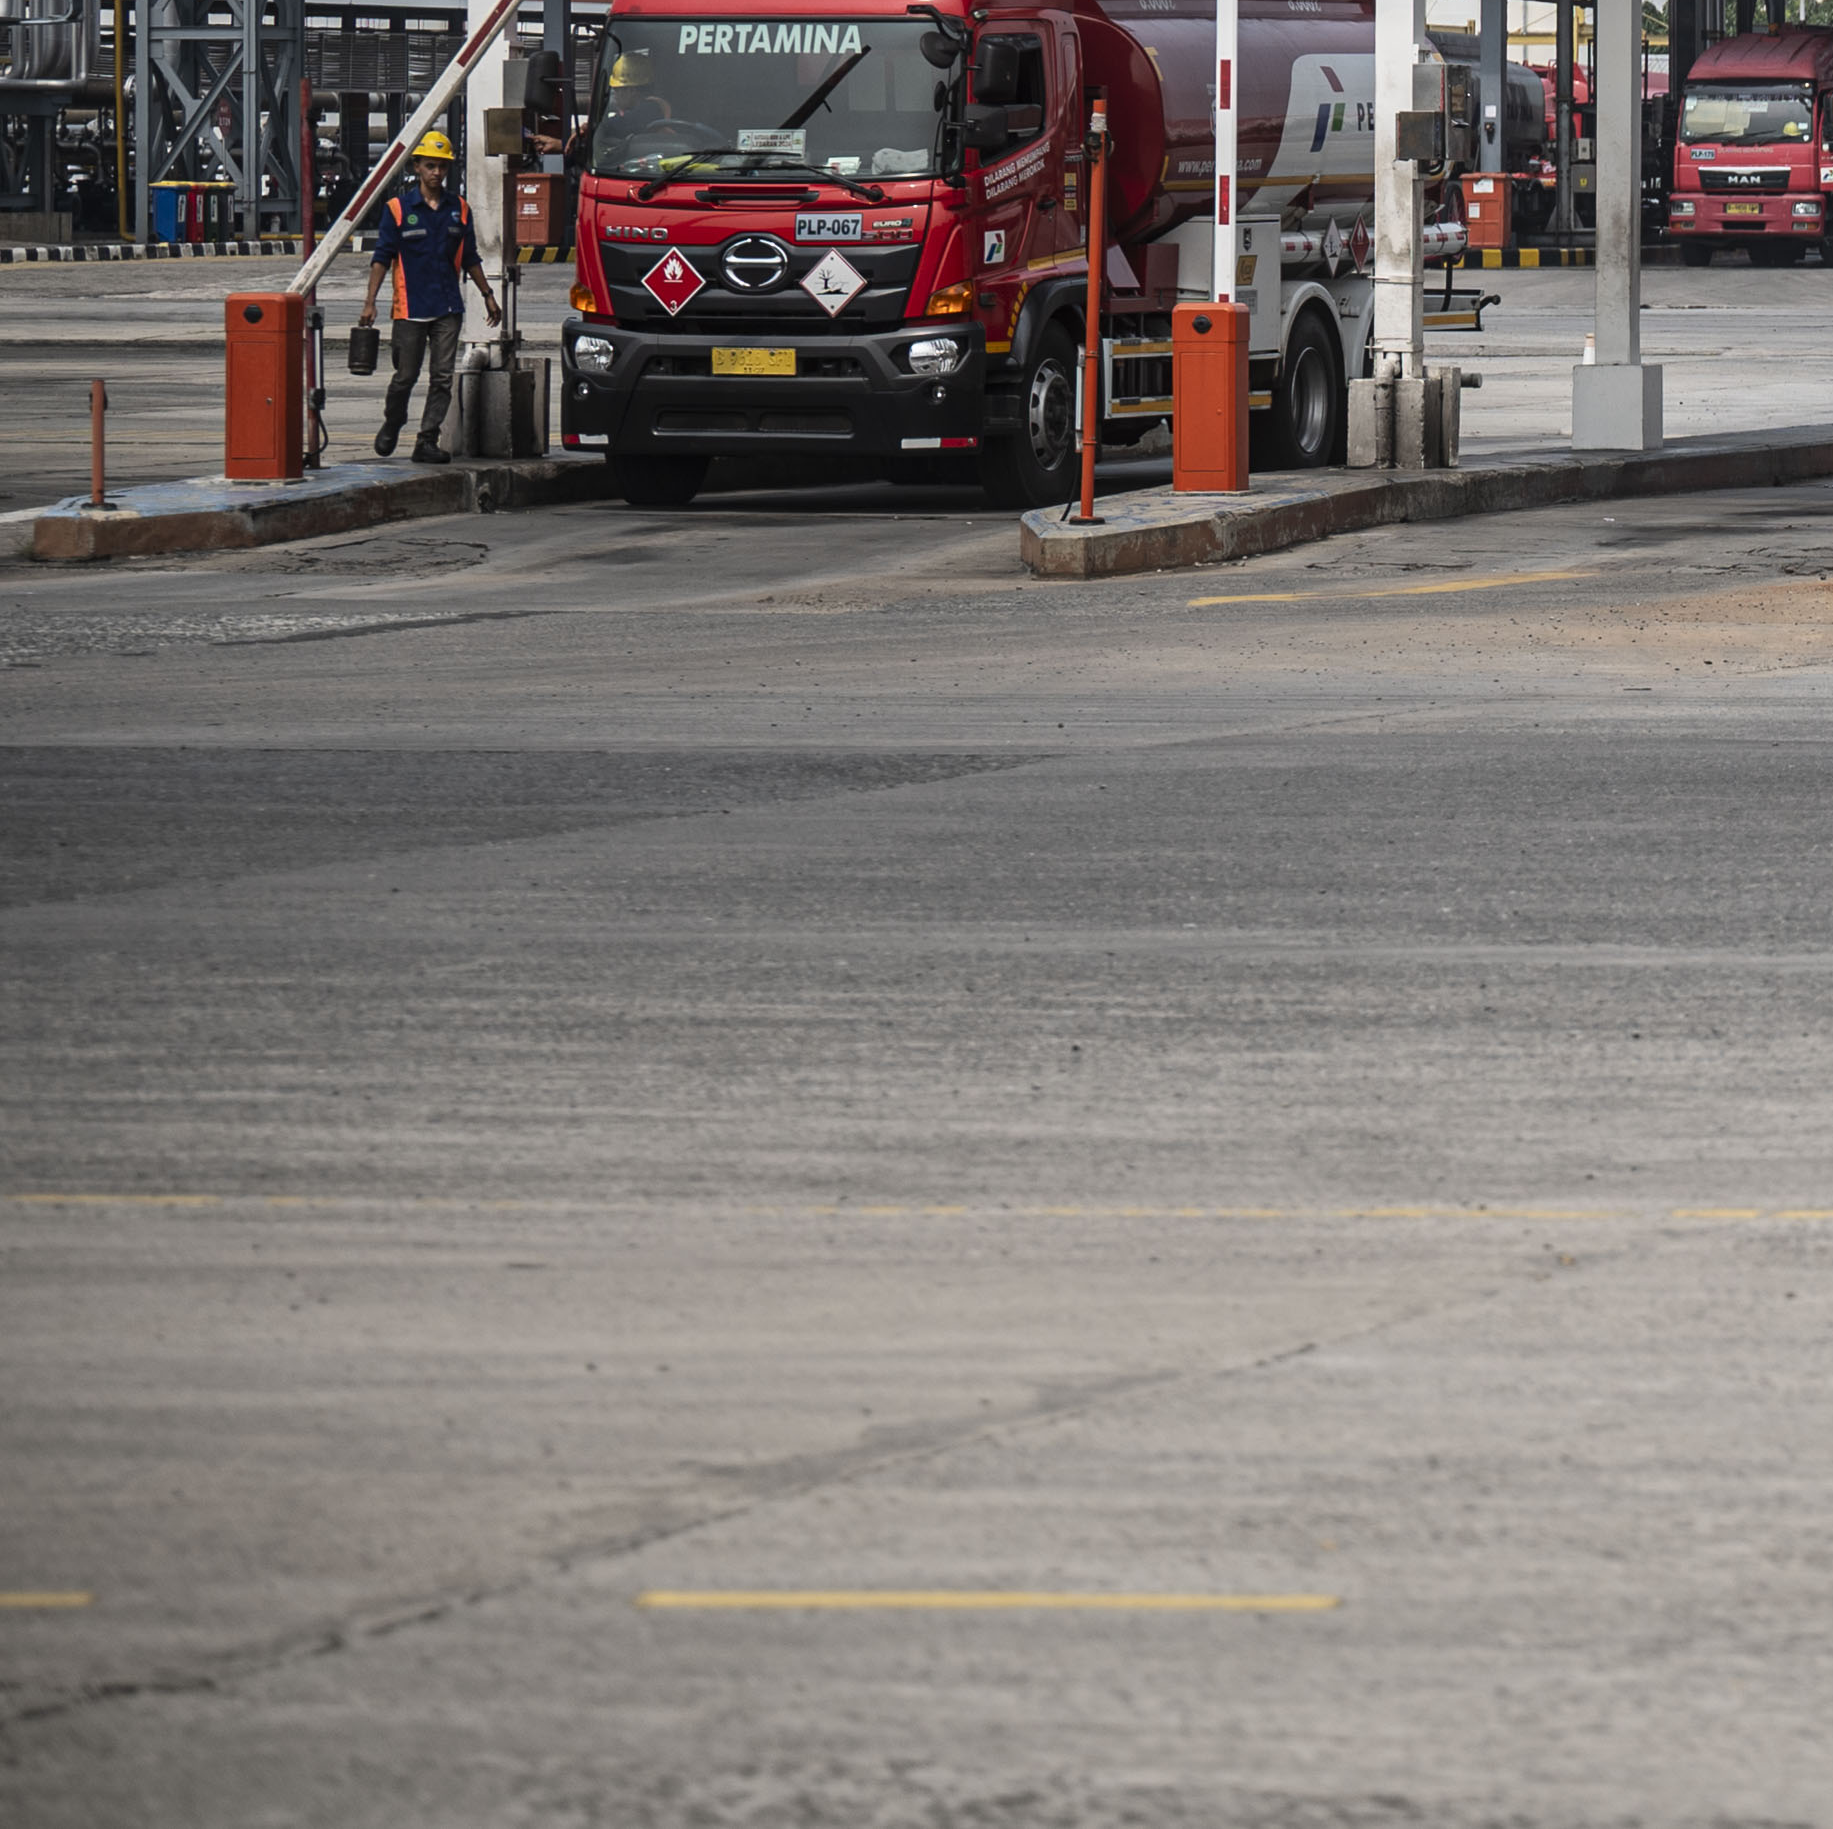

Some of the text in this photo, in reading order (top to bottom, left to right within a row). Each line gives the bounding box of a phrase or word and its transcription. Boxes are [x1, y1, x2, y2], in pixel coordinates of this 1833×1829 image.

[678, 24, 862, 55] PERTAMINA
[1178, 157, 1263, 176] www.pera.com
[1727, 175, 1761, 184] MAN
[605, 225, 668, 241] HINO
[797, 218, 861, 236] PLP-067
[861, 229, 914, 241] 500
[669, 300, 678, 312] 3
